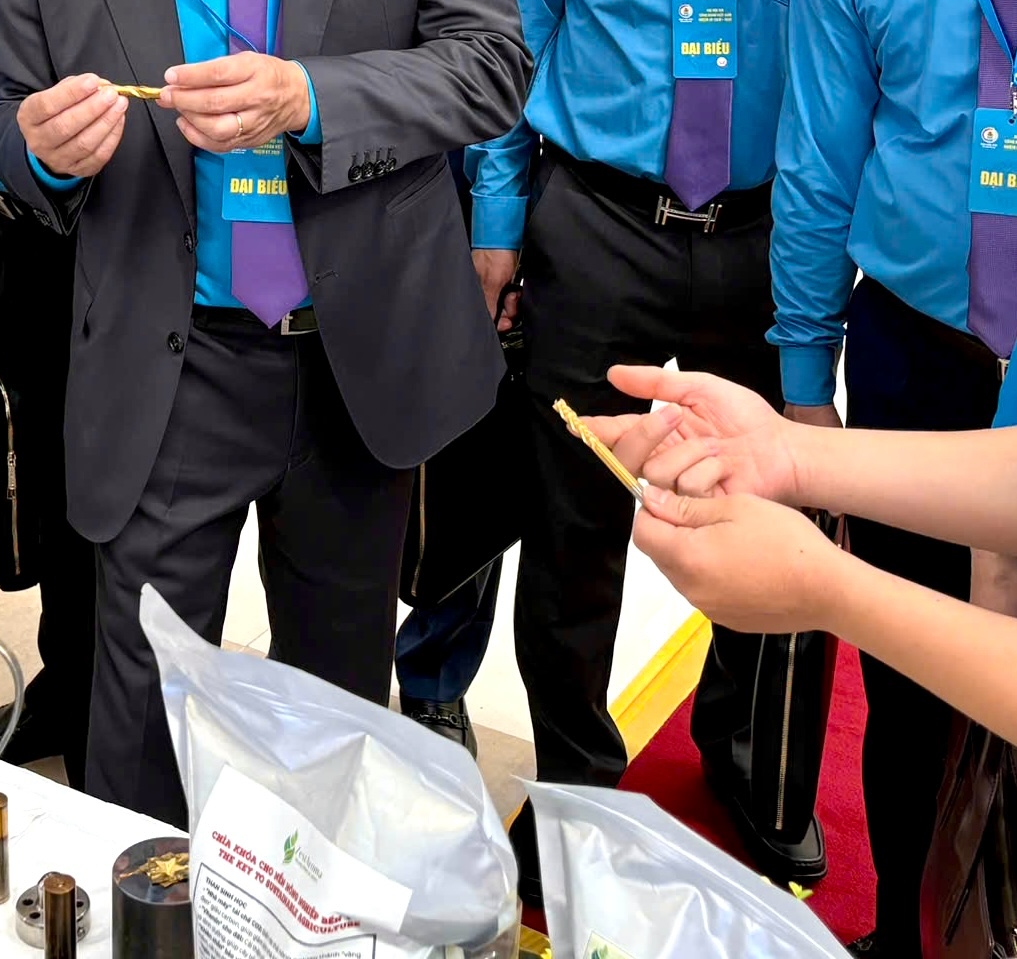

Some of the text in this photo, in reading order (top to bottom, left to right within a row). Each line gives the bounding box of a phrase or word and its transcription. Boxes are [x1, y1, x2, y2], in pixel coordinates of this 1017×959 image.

[681, 42, 700, 57] ĐẠI
[230, 177, 253, 196] ĐẠI
[980, 170, 1017, 189] ĐẠI B
[212, 830, 232, 849] CHÌA
[233, 843, 257, 865] KHÓA
[259, 860, 274, 876] CHO
[218, 848, 235, 865] THE
[235, 859, 254, 876] KEY
[254, 870, 265, 884] TO
